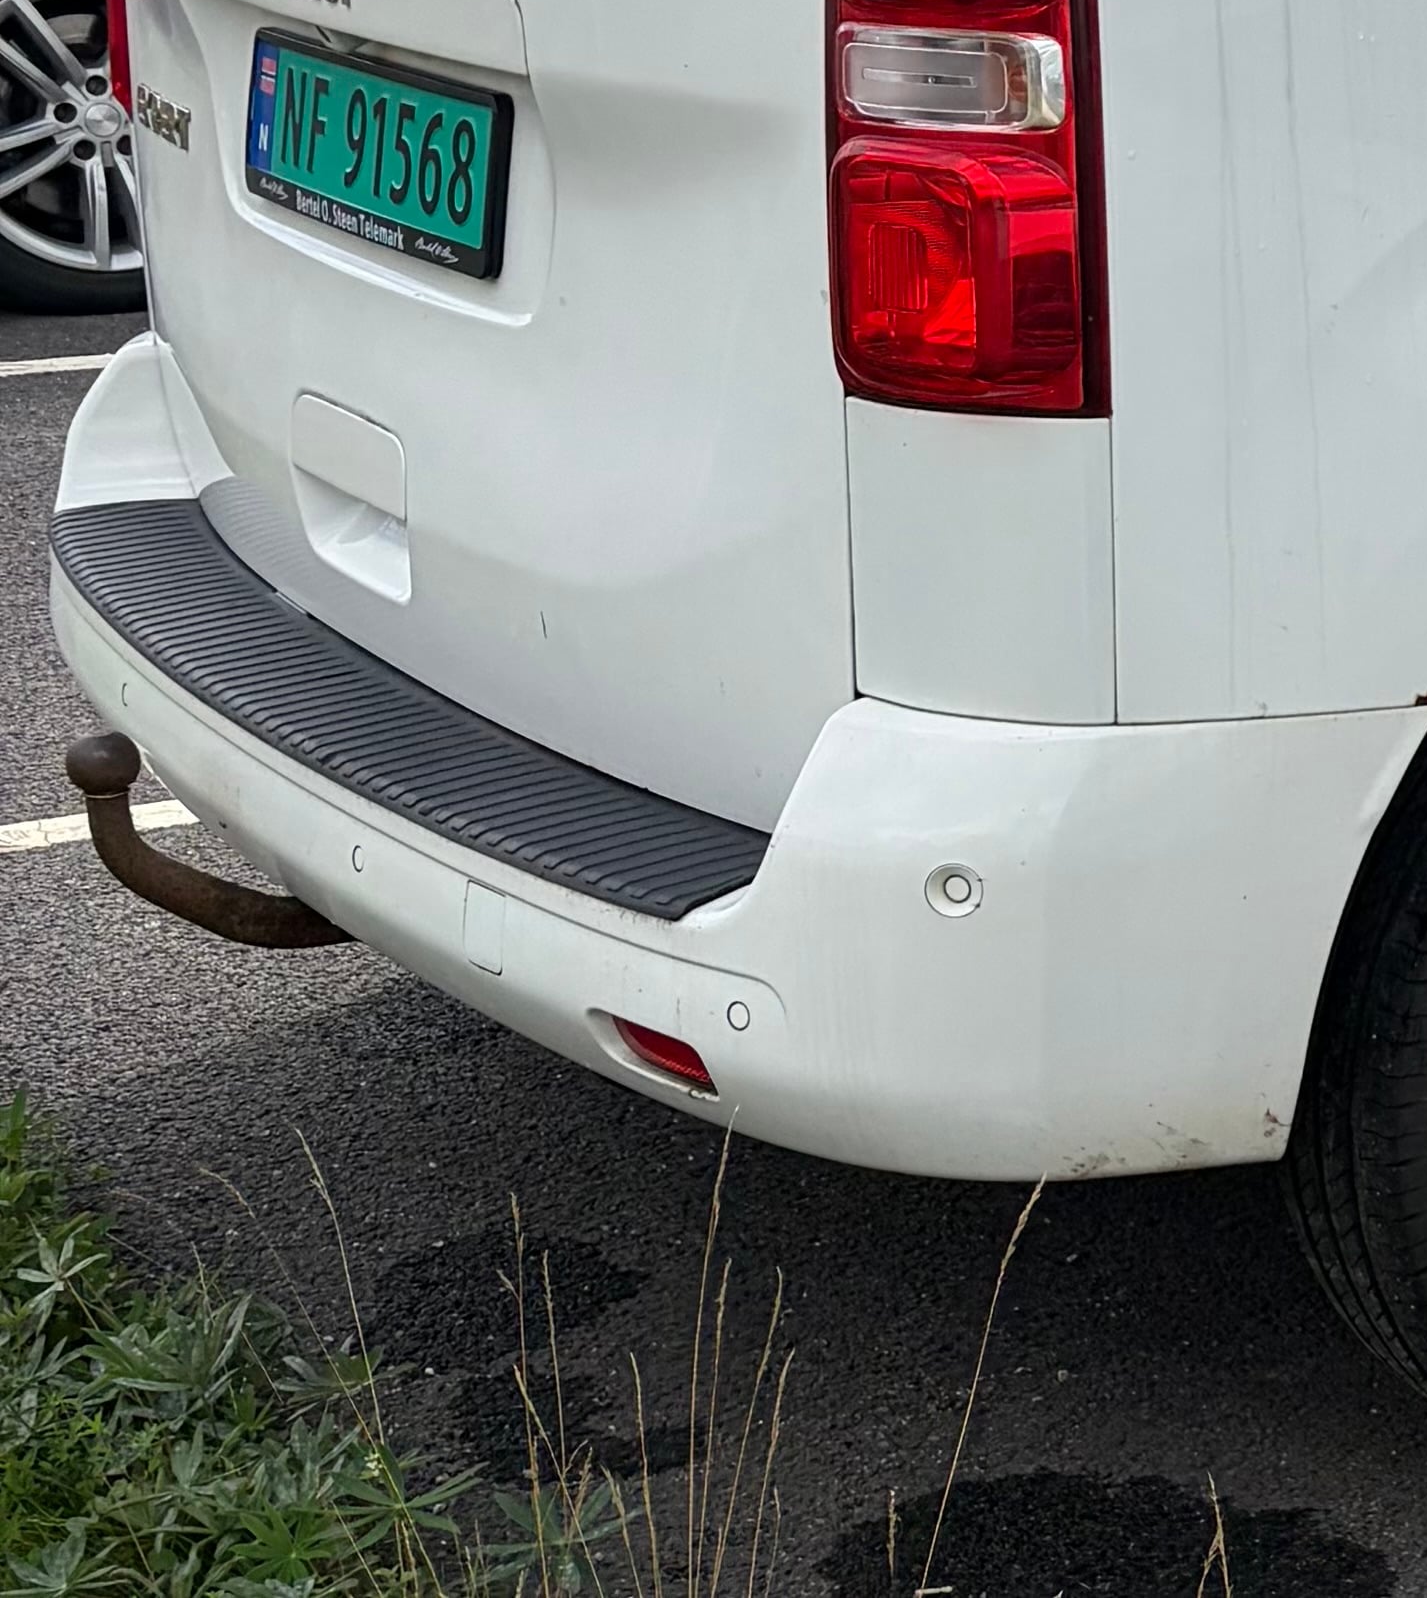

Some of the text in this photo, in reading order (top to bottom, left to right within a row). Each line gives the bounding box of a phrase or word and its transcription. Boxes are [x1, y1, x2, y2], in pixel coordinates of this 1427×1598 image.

[257, 122, 270, 152] N
[280, 66, 477, 227] NF 91568
[296, 188, 320, 219] Bertel
[321, 199, 332, 224] O.
[332, 203, 359, 234] Steen
[358, 213, 405, 251] Telemark
